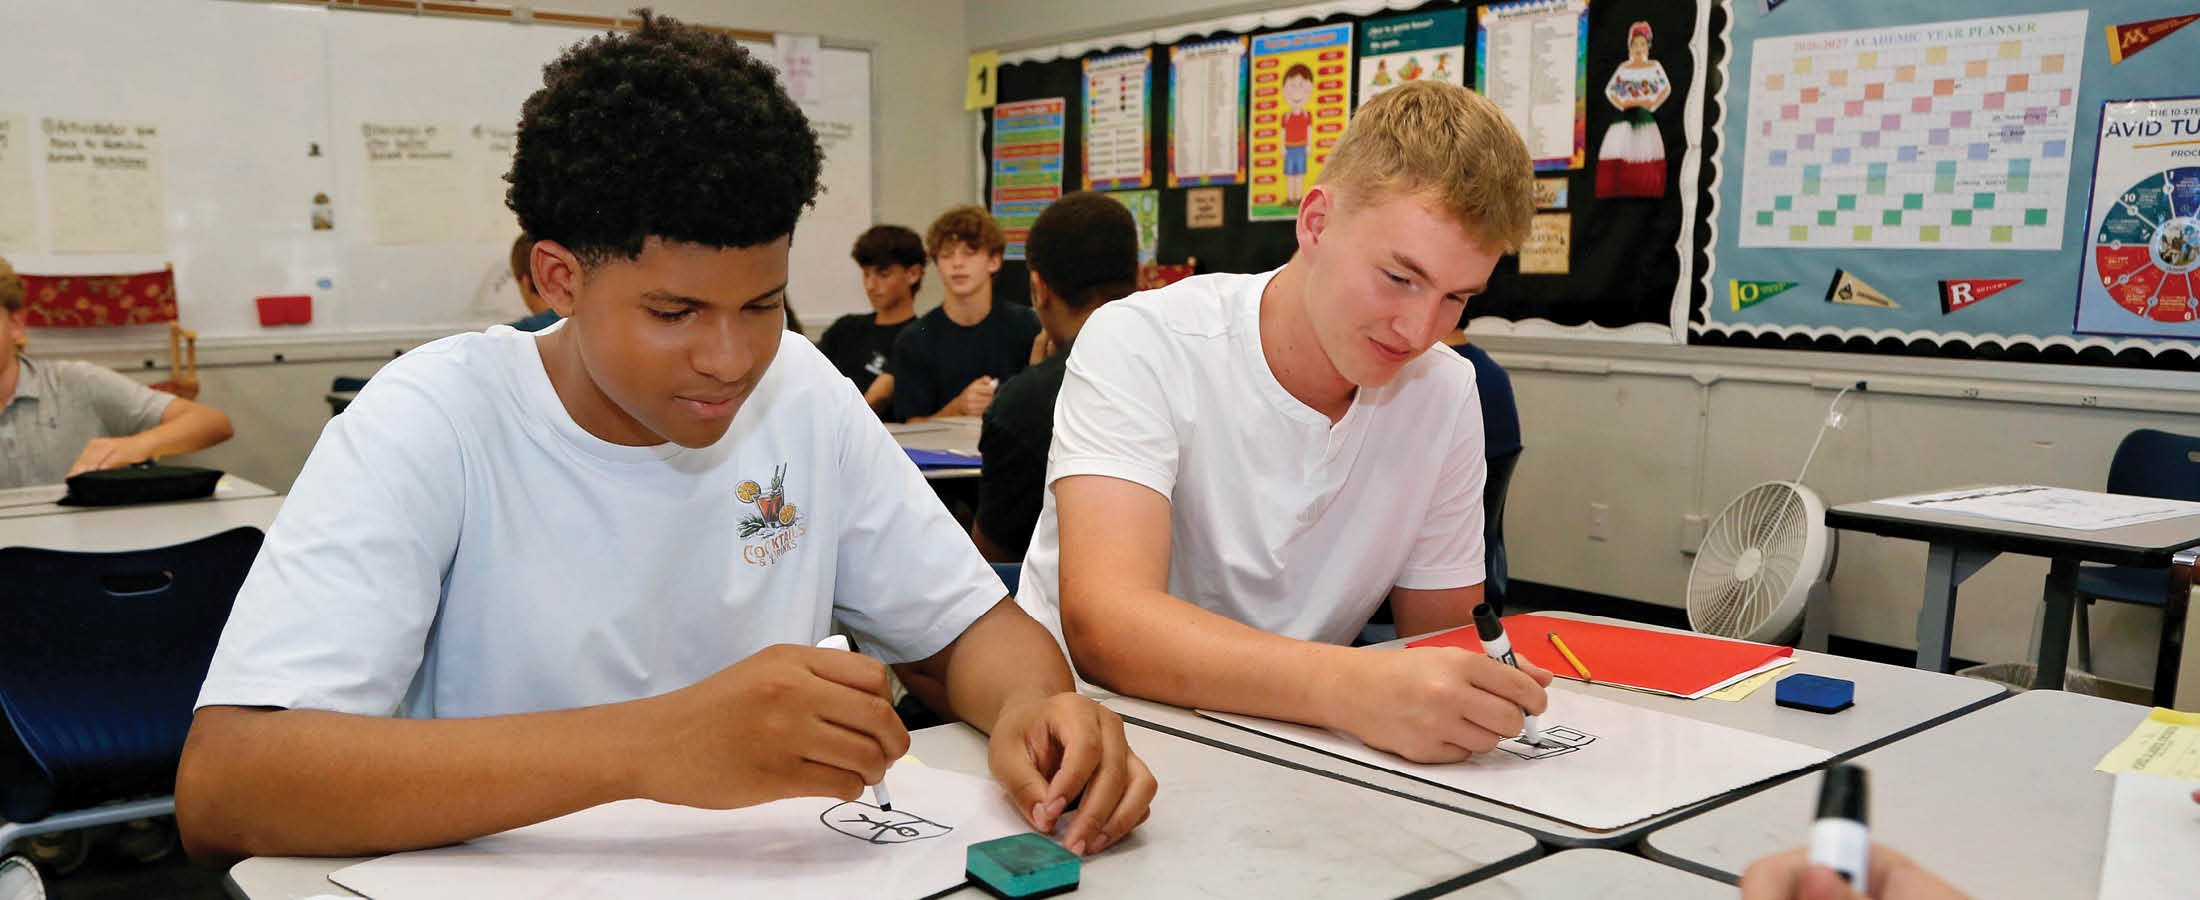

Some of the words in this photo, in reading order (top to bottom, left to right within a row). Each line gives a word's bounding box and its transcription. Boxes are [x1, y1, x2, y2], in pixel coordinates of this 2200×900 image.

[1853, 31, 1921, 47] ACADEMIC
[1927, 27, 1964, 41] YEAR
[1968, 23, 2038, 39] PLANNER
[977, 66, 988, 96] 1
[2150, 109, 2168, 117] THE
[2105, 120, 2162, 138] AVID
[2169, 171, 2175, 179] 1
[2124, 193, 2136, 202] 10
[2104, 276, 2112, 284] 8
[1740, 283, 1760, 302] O
[1951, 282, 1975, 305] R
[2137, 306, 2144, 314] 7
[2184, 312, 2192, 320] 6
